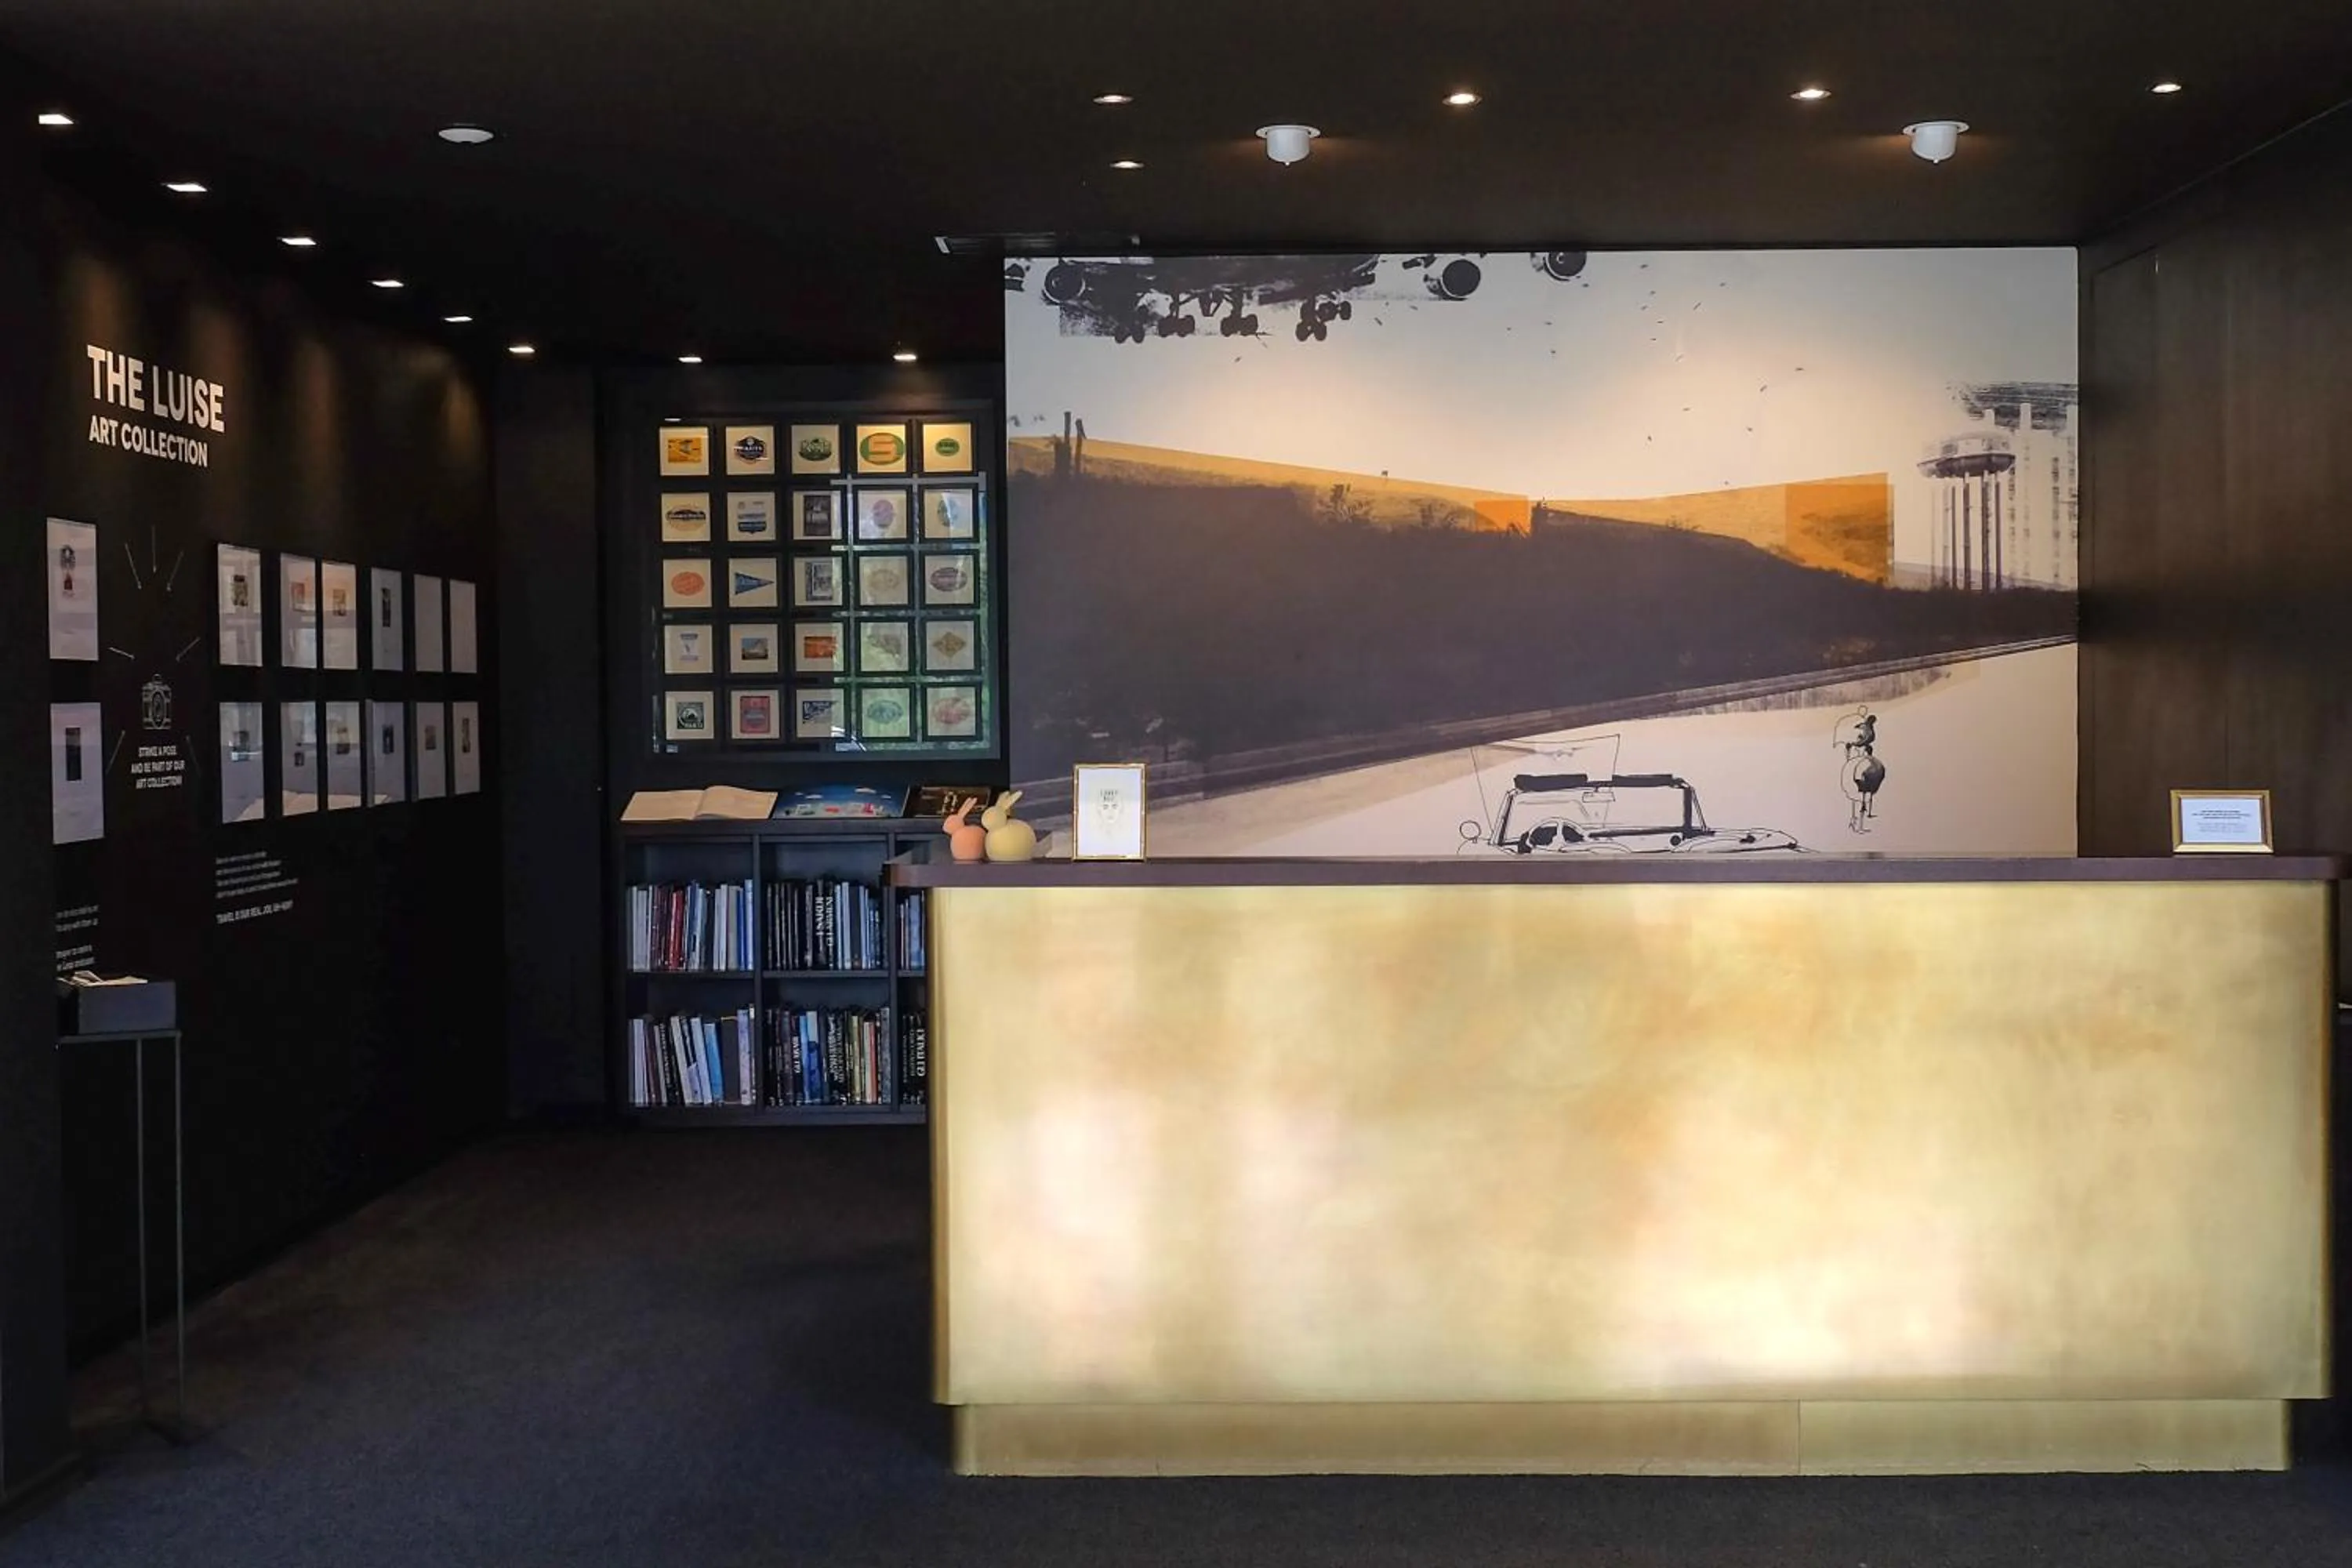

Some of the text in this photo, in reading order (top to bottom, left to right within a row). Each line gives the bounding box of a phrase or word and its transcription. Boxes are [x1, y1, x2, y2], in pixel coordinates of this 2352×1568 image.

[87, 344, 225, 434] THE LUISE
[89, 414, 209, 468] ART COLLECTION
